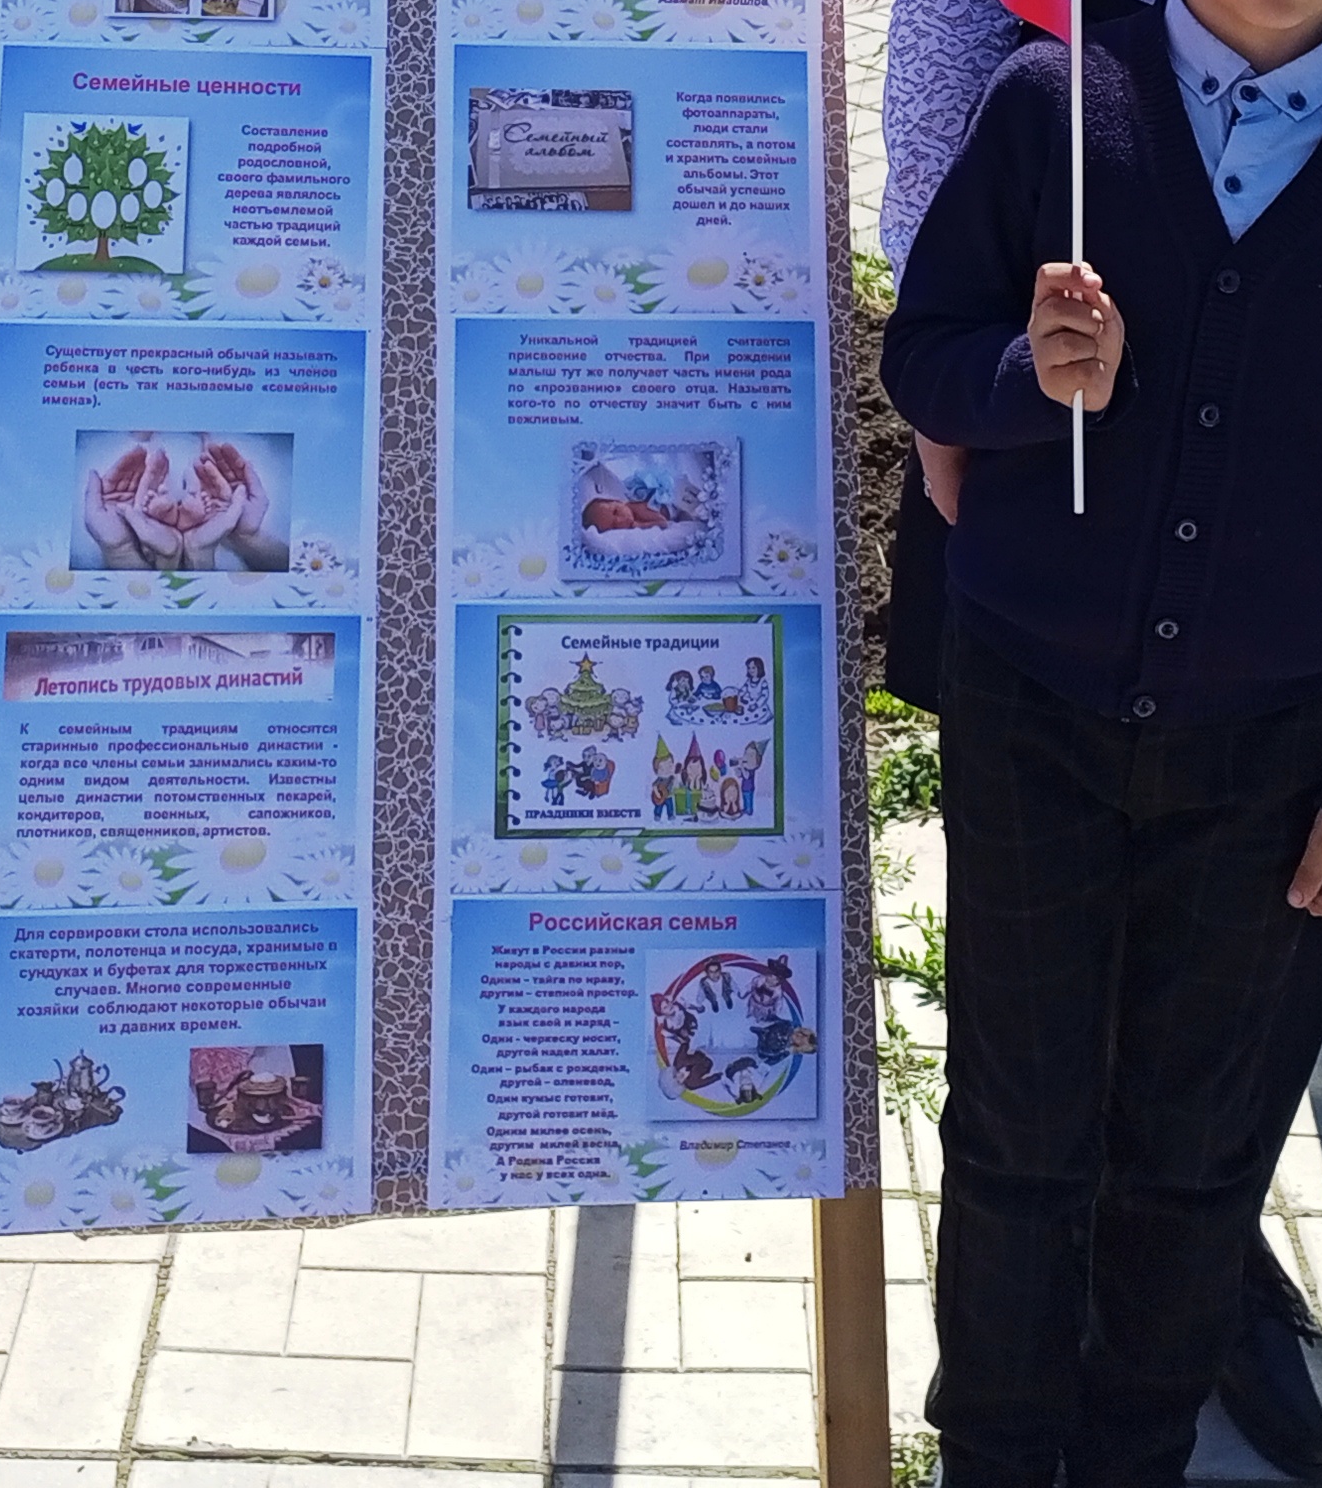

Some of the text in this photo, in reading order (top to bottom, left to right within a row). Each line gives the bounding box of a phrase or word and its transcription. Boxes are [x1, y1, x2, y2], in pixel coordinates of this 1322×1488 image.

[73, 72, 301, 96] Семейные ценности
[242, 125, 328, 137] Составление
[504, 122, 608, 143] Семейный
[248, 142, 321, 154] подробной
[525, 144, 595, 158] альбом
[238, 156, 331, 170] родословной,
[218, 172, 350, 186] своего фамильного
[226, 189, 341, 200] дерева являлось
[233, 204, 333, 216] неотъемлемой
[224, 220, 340, 233] частью традиций
[233, 236, 330, 247] каждой семьи.
[46, 345, 337, 361] Существует прекрасный обычай называть
[562, 636, 719, 651] Семейные традиции
[35, 667, 302, 696] Летопись трудовых династий
[20, 724, 337, 736] К семейным традициям относятся
[529, 913, 737, 933] Российская семья
[14, 922, 318, 942] Для сервировки стола использовались
